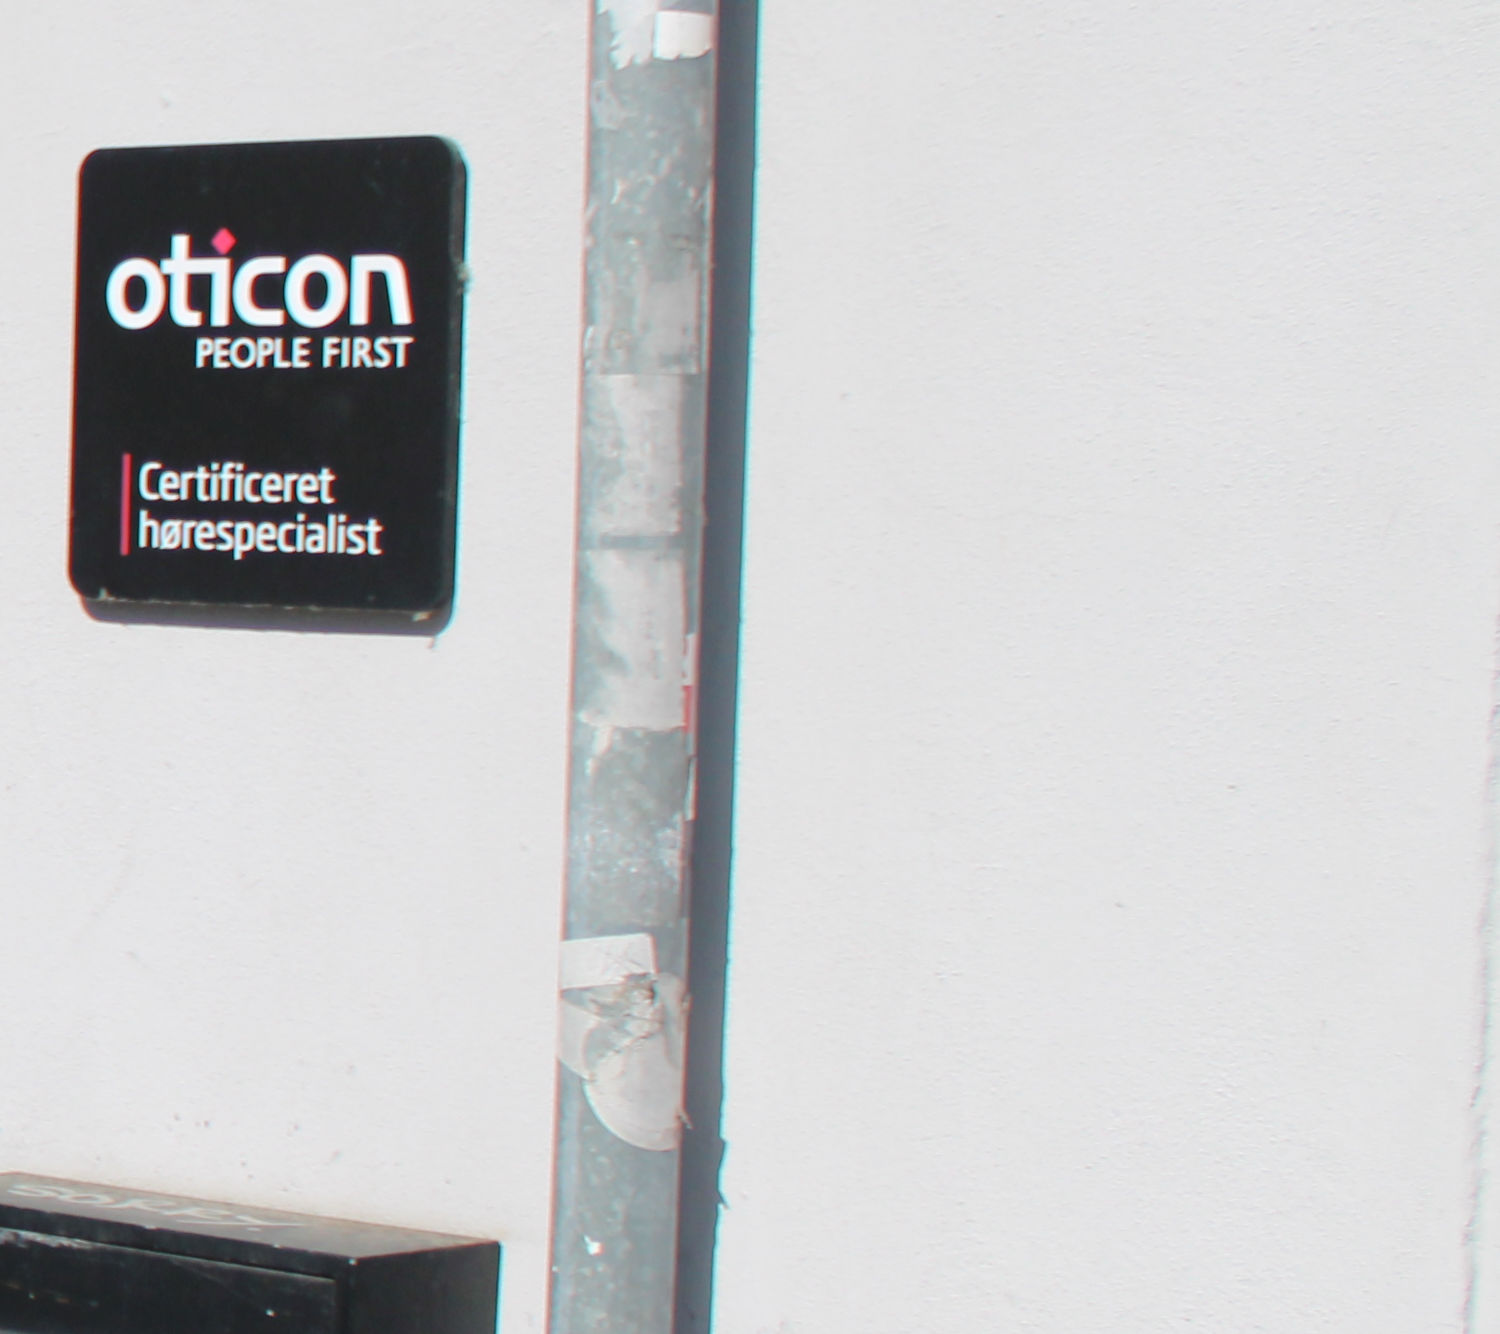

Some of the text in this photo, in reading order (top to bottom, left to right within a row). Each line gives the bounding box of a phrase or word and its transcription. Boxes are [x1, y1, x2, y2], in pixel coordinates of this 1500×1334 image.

[105, 227, 413, 330] oticon
[195, 336, 415, 369] PEOPLE FIRST
[138, 461, 336, 504] Certificeret
[138, 510, 383, 560] hørespecialist
